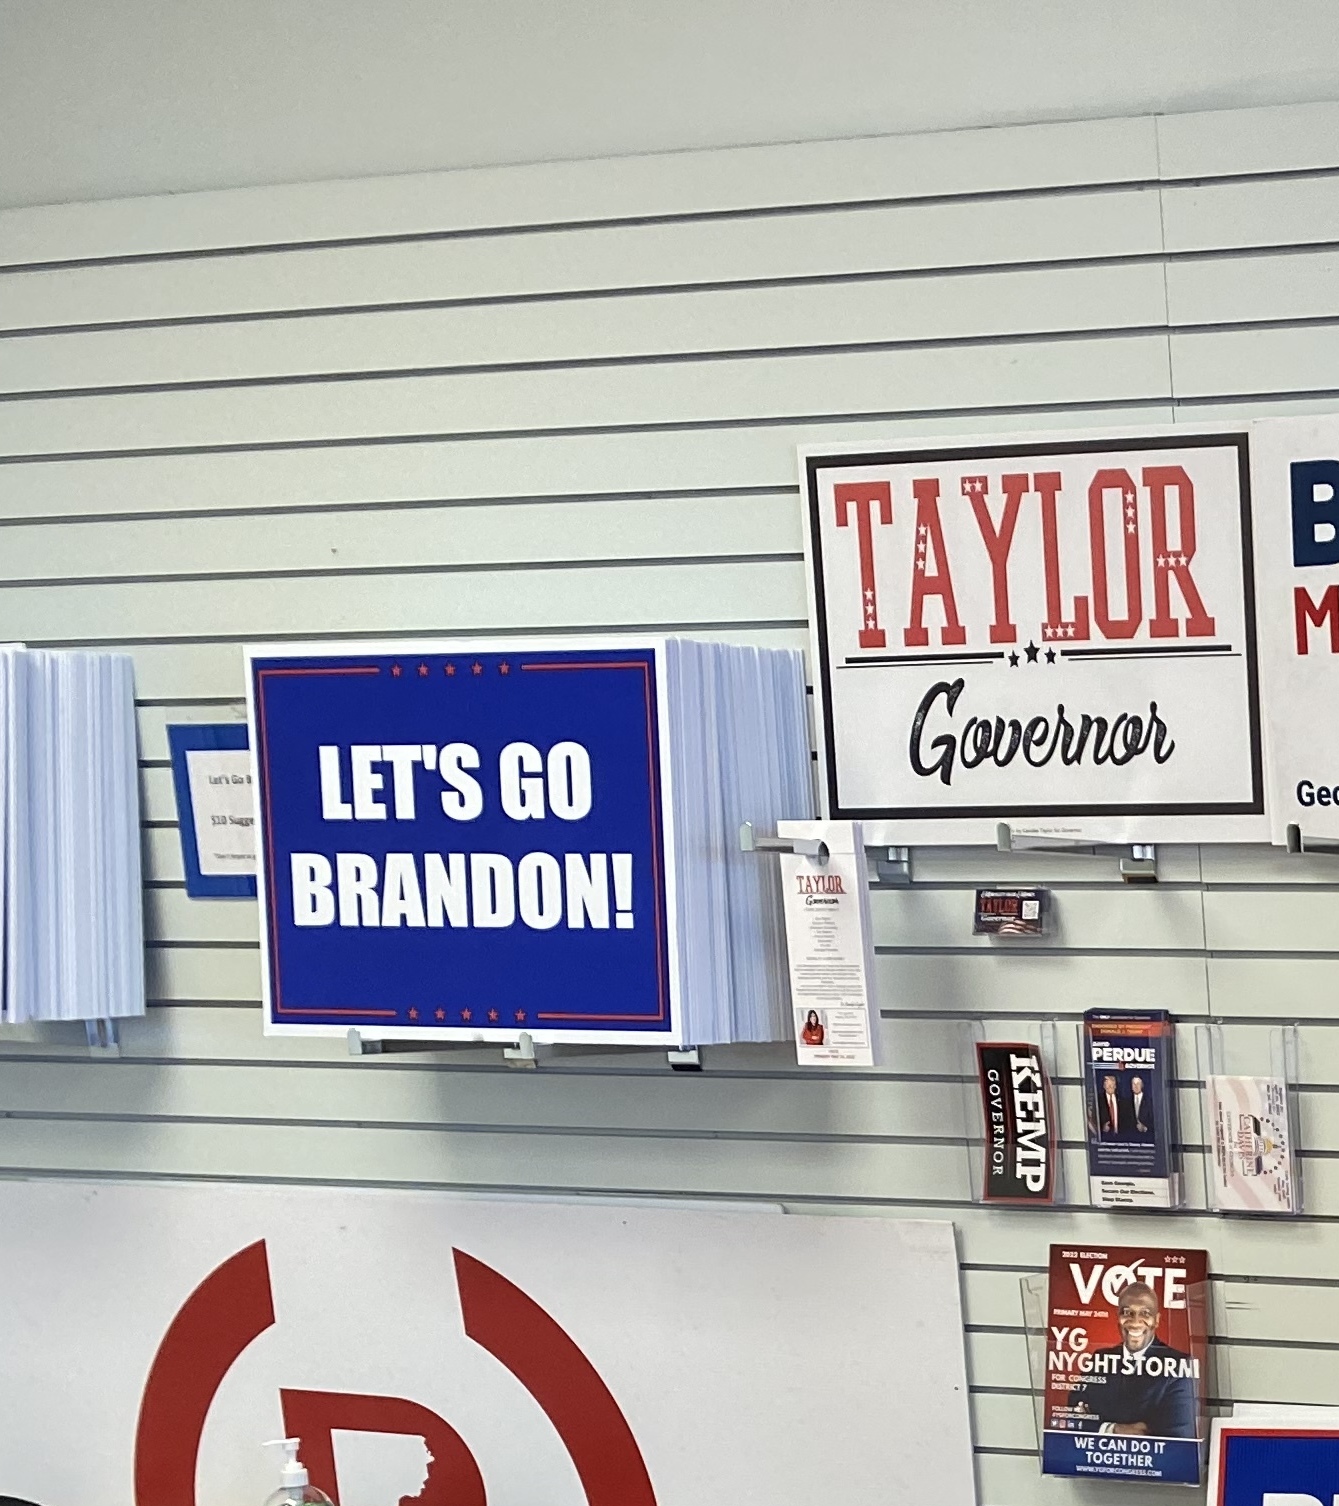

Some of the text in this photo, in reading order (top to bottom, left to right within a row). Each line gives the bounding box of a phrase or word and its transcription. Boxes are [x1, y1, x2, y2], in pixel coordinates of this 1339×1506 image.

[833, 465, 1216, 649] TAYLOR
[909, 677, 1176, 787] Governor
[318, 740, 592, 822] LET'S GO
[289, 850, 637, 931] BRANDON!
[796, 874, 845, 895] TAYLOR
[1091, 1047, 1156, 1063] PERDUE
[986, 1069, 1005, 1177] GOVERNOR
[1008, 1053, 1047, 1193] KEMP
[1069, 1262, 1187, 1309] VOTE
[1051, 1327, 1088, 1351] YG
[1048, 1351, 1200, 1379] NYGHTSTORM
[1052, 1374, 1107, 1384] FOR CONGRESS
[1052, 1383, 1079, 1391] DISTRICT
[1074, 1436, 1166, 1454] WE CAN DO IT
[1086, 1451, 1153, 1468] TOGETHER
